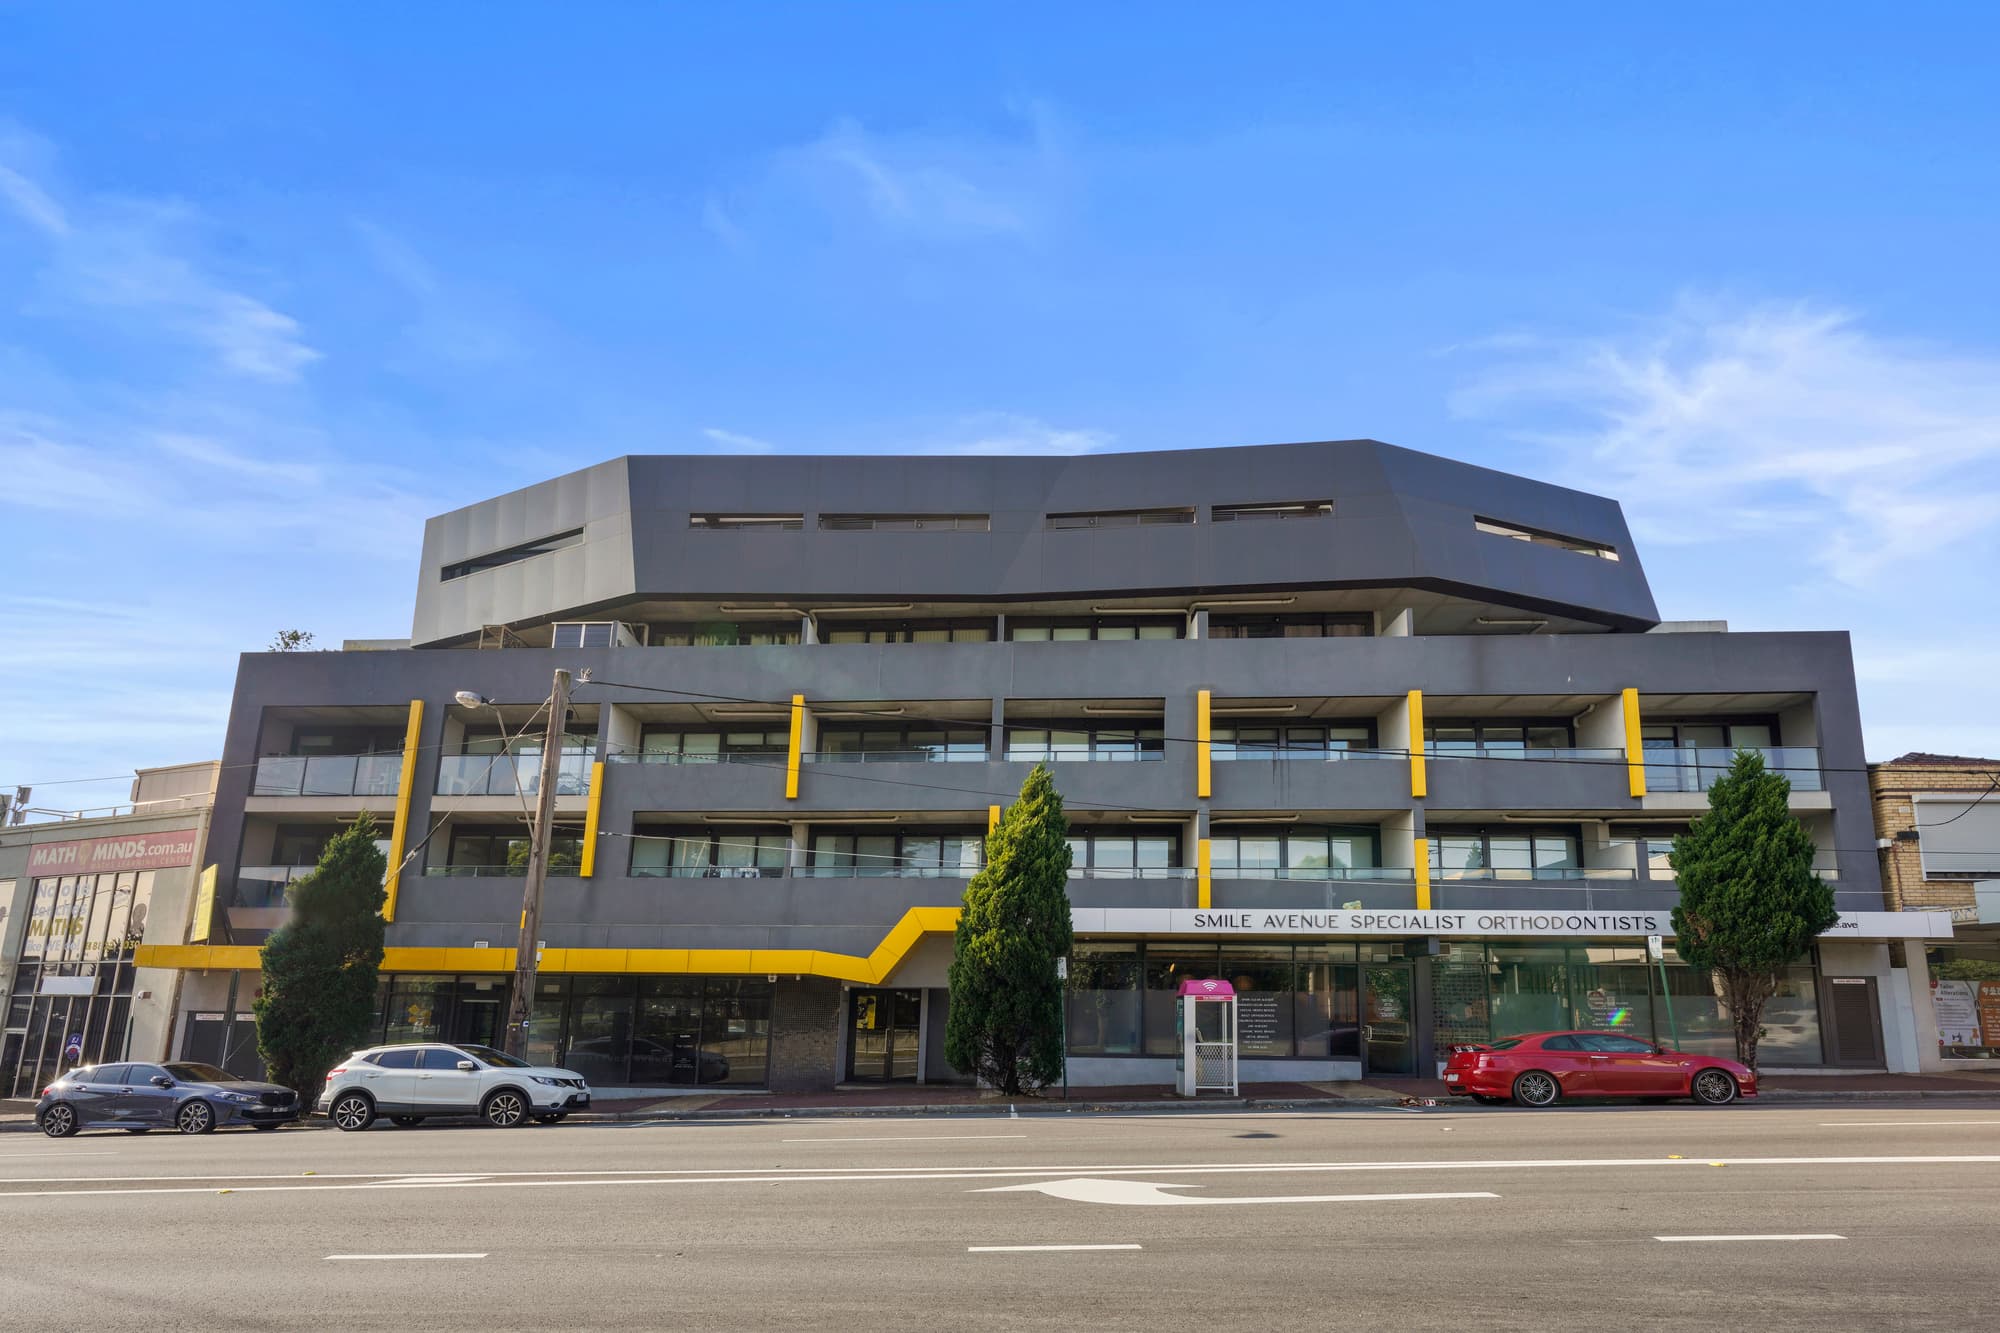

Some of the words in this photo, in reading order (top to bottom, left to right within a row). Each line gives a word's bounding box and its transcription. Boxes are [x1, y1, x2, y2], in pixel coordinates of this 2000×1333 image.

[33, 847, 77, 865] MATH
[92, 839, 193, 861] MINDS.com.au
[28, 916, 84, 937] MATHS
[1194, 914, 1252, 928] SMILE
[1263, 914, 1339, 929] AVENUE
[1351, 915, 1465, 929] SPECIALIST
[1477, 915, 1657, 930] ORTHODONTISTS
